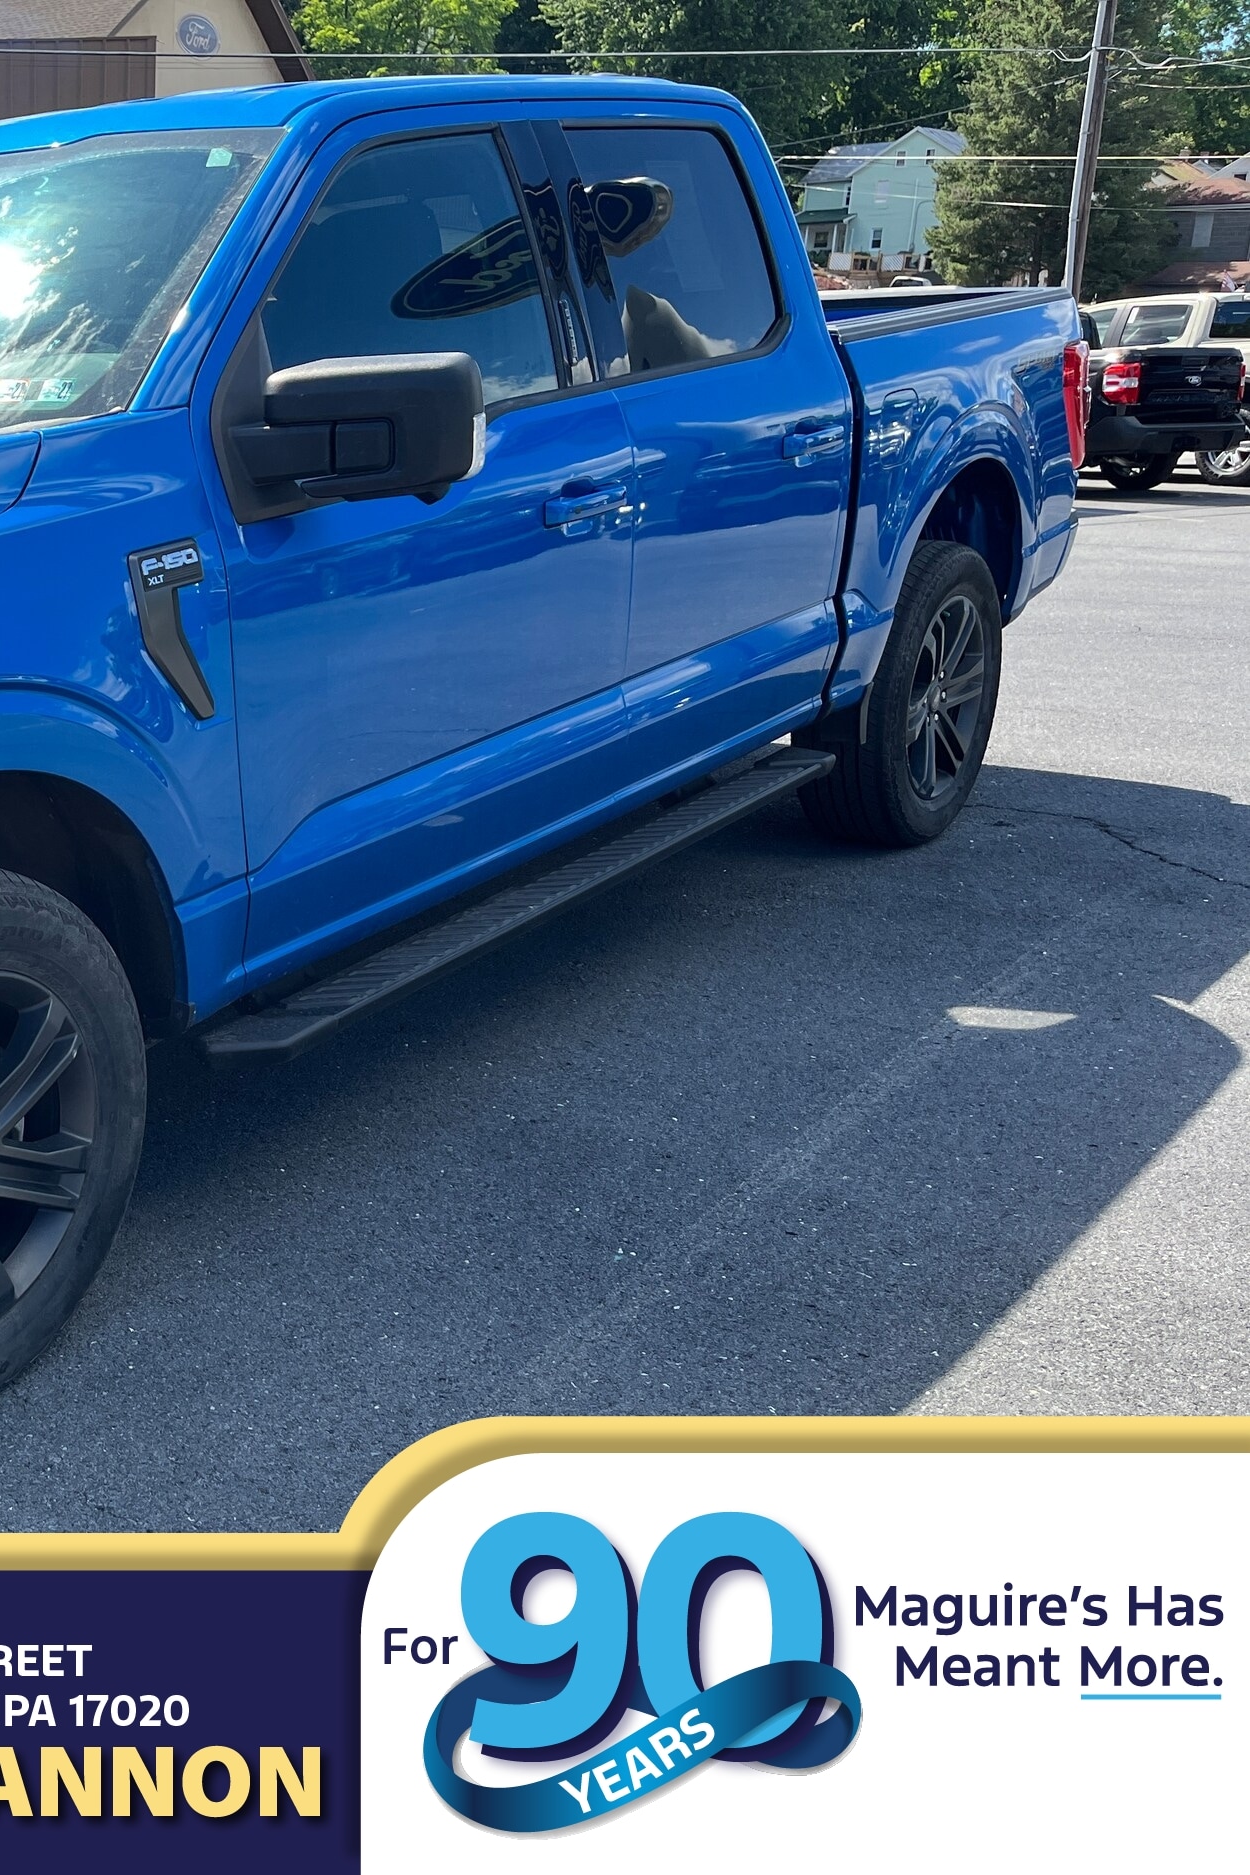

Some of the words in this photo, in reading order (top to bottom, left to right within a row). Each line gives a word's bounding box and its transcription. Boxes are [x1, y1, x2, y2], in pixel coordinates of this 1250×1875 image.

[185, 21, 211, 50] Ford
[140, 548, 199, 576] F-150
[147, 574, 164, 587] XLT
